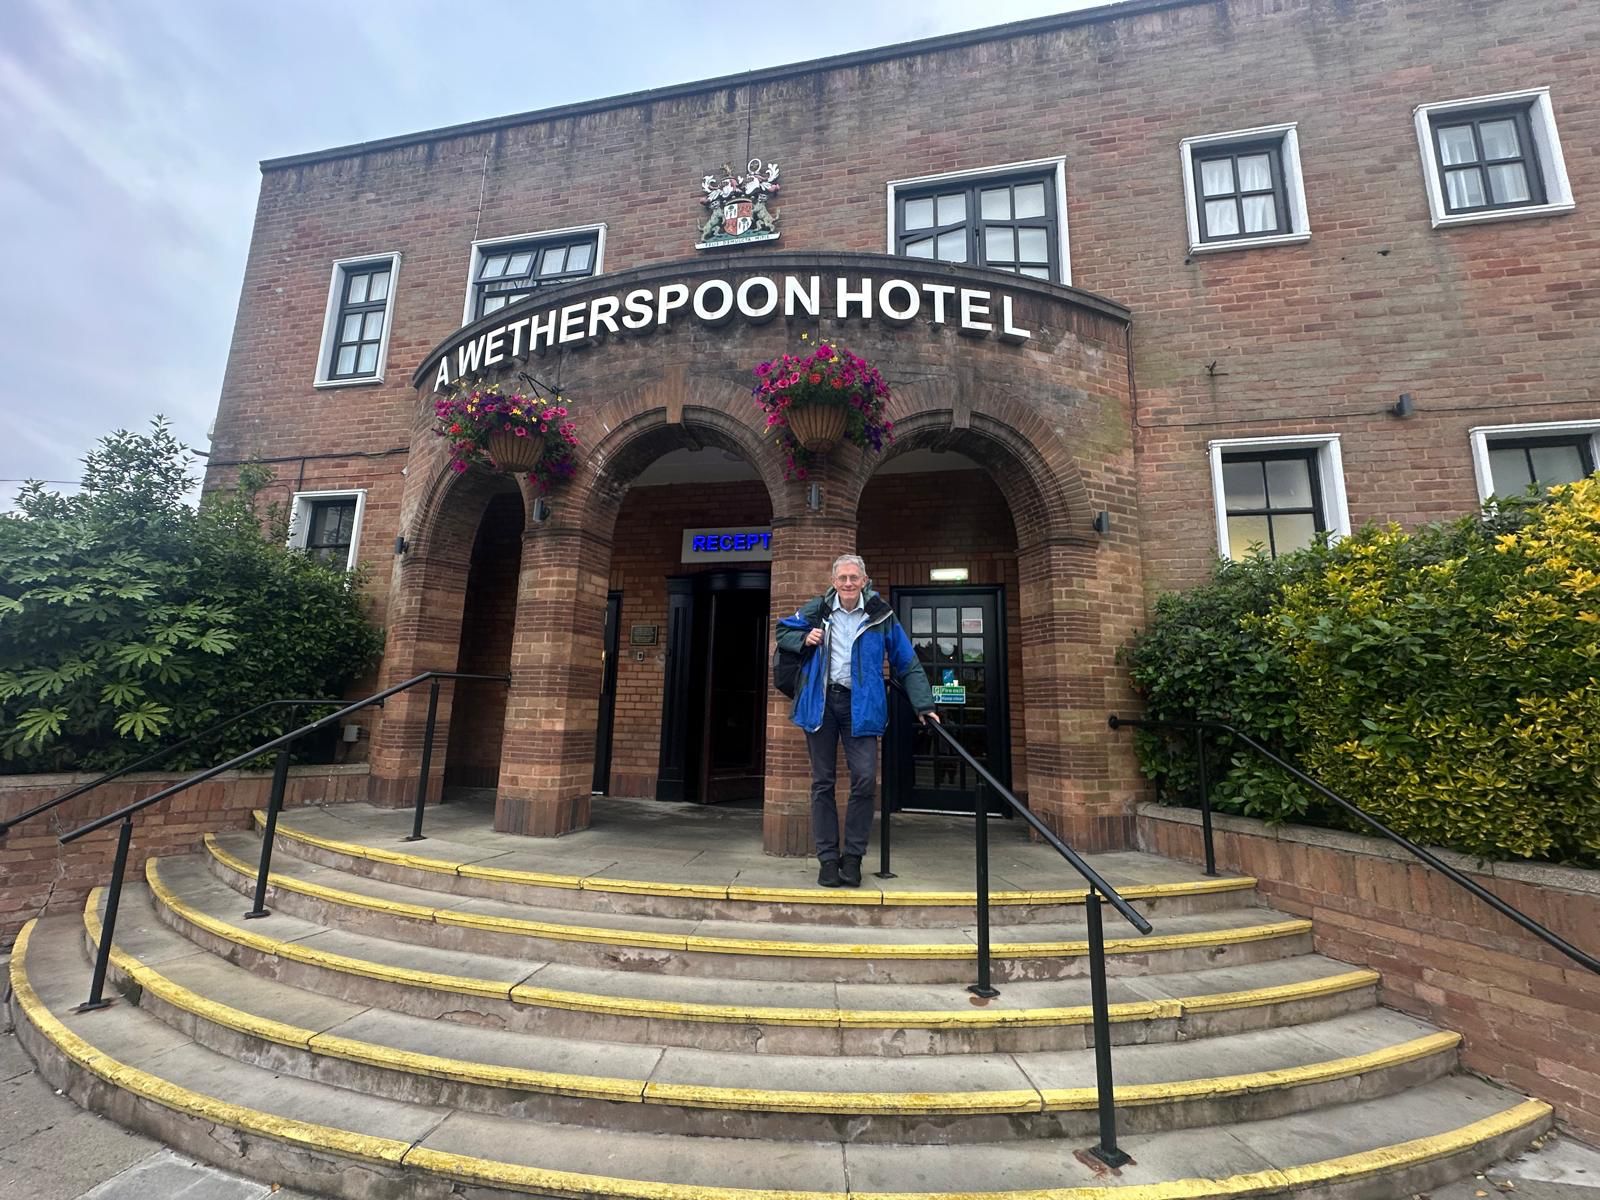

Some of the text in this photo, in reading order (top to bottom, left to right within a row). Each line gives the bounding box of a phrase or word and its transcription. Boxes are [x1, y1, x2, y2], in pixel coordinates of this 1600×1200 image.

[433, 275, 1031, 393] A WETHERSPOON HOTEL
[692, 533, 772, 551] RECEPT
